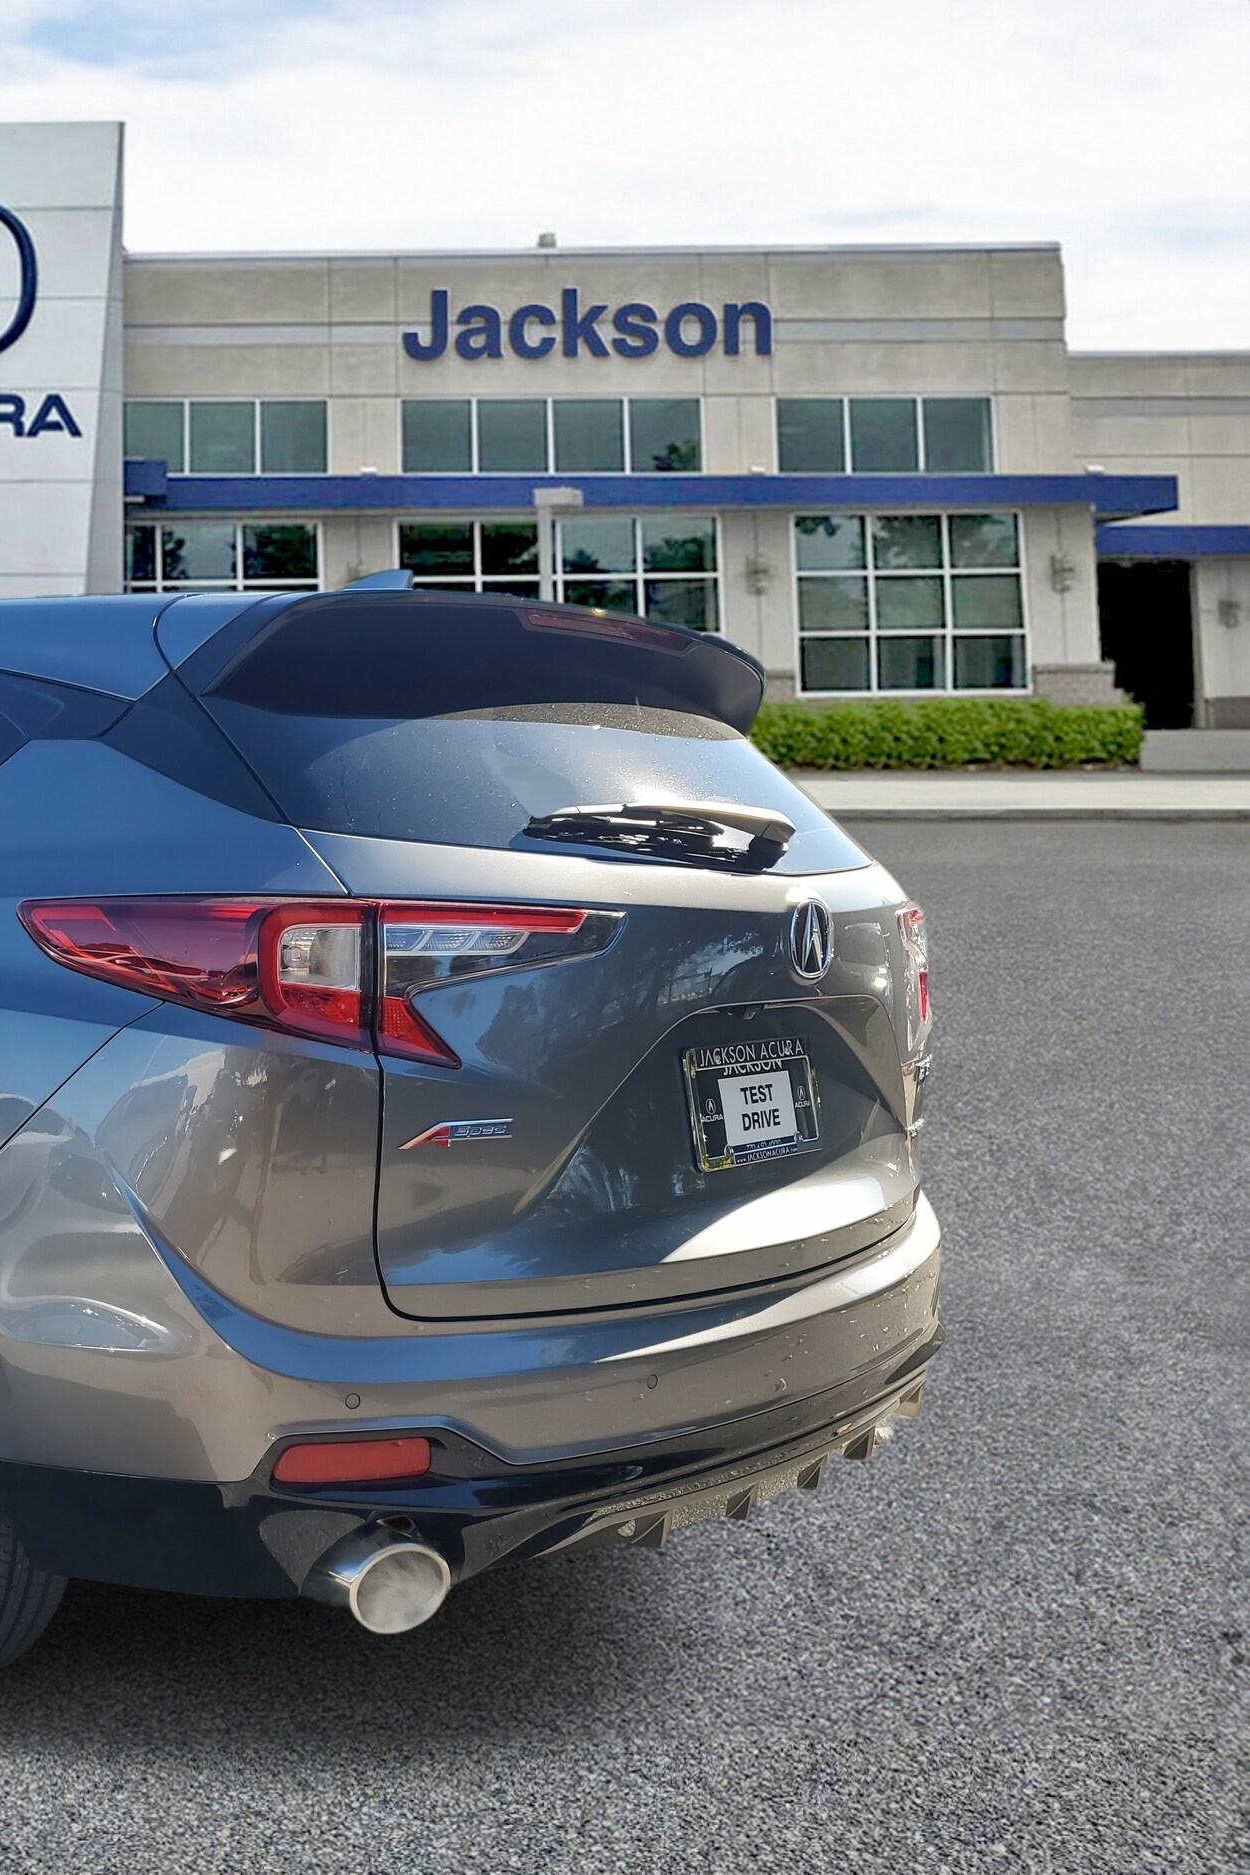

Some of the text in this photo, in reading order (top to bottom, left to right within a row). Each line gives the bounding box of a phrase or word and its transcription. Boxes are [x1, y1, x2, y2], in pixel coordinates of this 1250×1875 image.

[402, 287, 773, 362] Jackson
[700, 1038, 804, 1067] JACKSON ACURA
[740, 1083, 773, 1105] TEST
[741, 1108, 781, 1131] DRIVE
